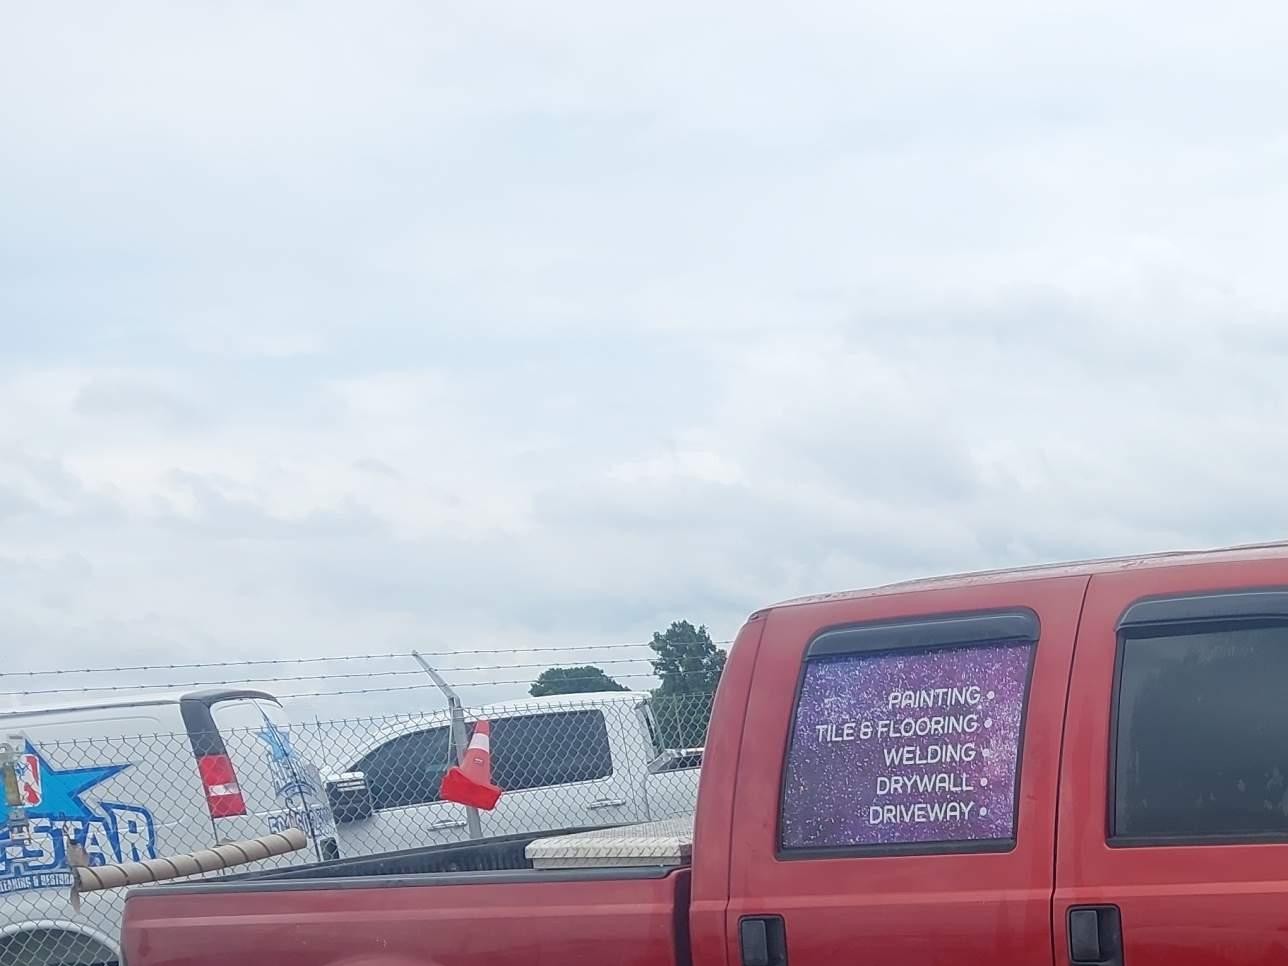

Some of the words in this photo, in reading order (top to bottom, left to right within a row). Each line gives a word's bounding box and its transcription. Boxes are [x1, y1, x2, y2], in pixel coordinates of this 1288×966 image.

[888, 686, 981, 709] PAINTING
[816, 722, 855, 742] TILE
[860, 722, 873, 739] &
[877, 714, 978, 739] FLOORING
[883, 743, 976, 767] WELDING
[876, 774, 974, 795] DRYWALL
[869, 802, 974, 824] DRIVEWAY
[40, 873, 75, 886] RESTORA
